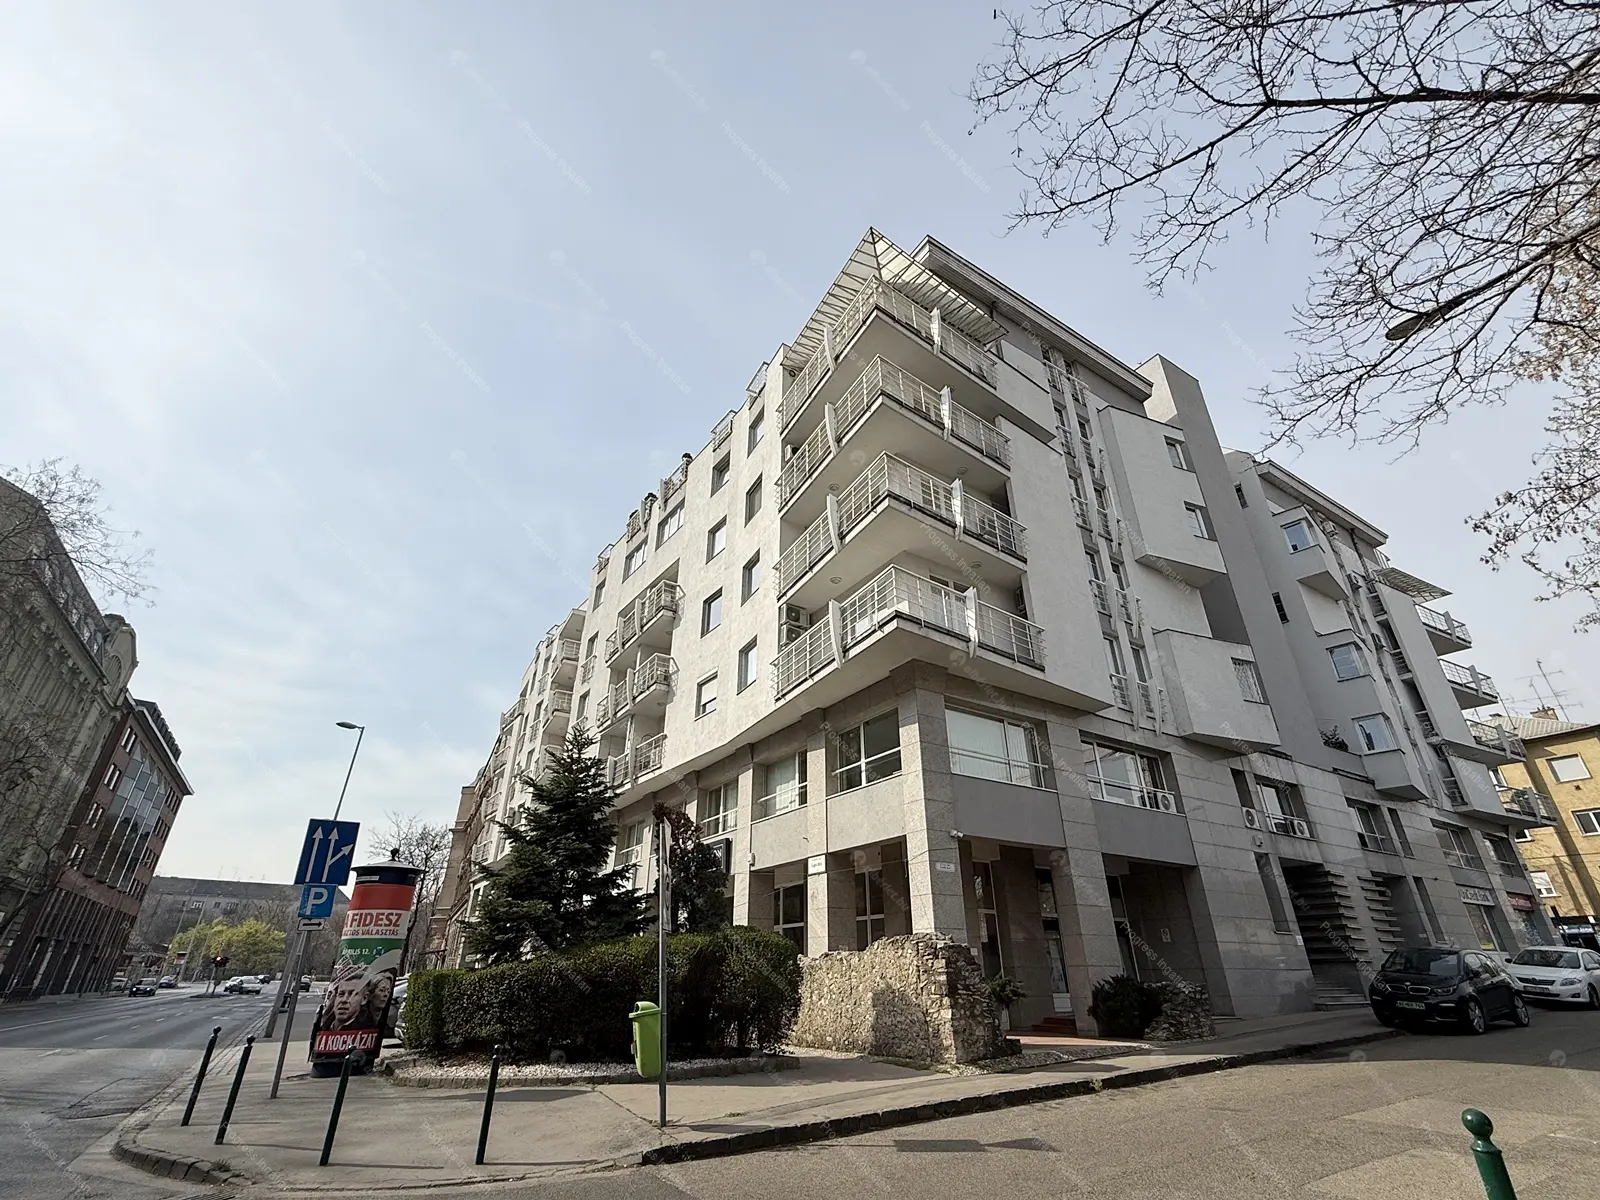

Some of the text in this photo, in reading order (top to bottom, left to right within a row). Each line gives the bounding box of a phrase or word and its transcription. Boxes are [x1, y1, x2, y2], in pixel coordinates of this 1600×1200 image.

[305, 887, 328, 915] P
[350, 912, 402, 927] FIDESZ
[361, 928, 399, 936] VÁLASZTÁS
[319, 1035, 326, 1051] A
[326, 1031, 378, 1051] KOCKÁZAT
